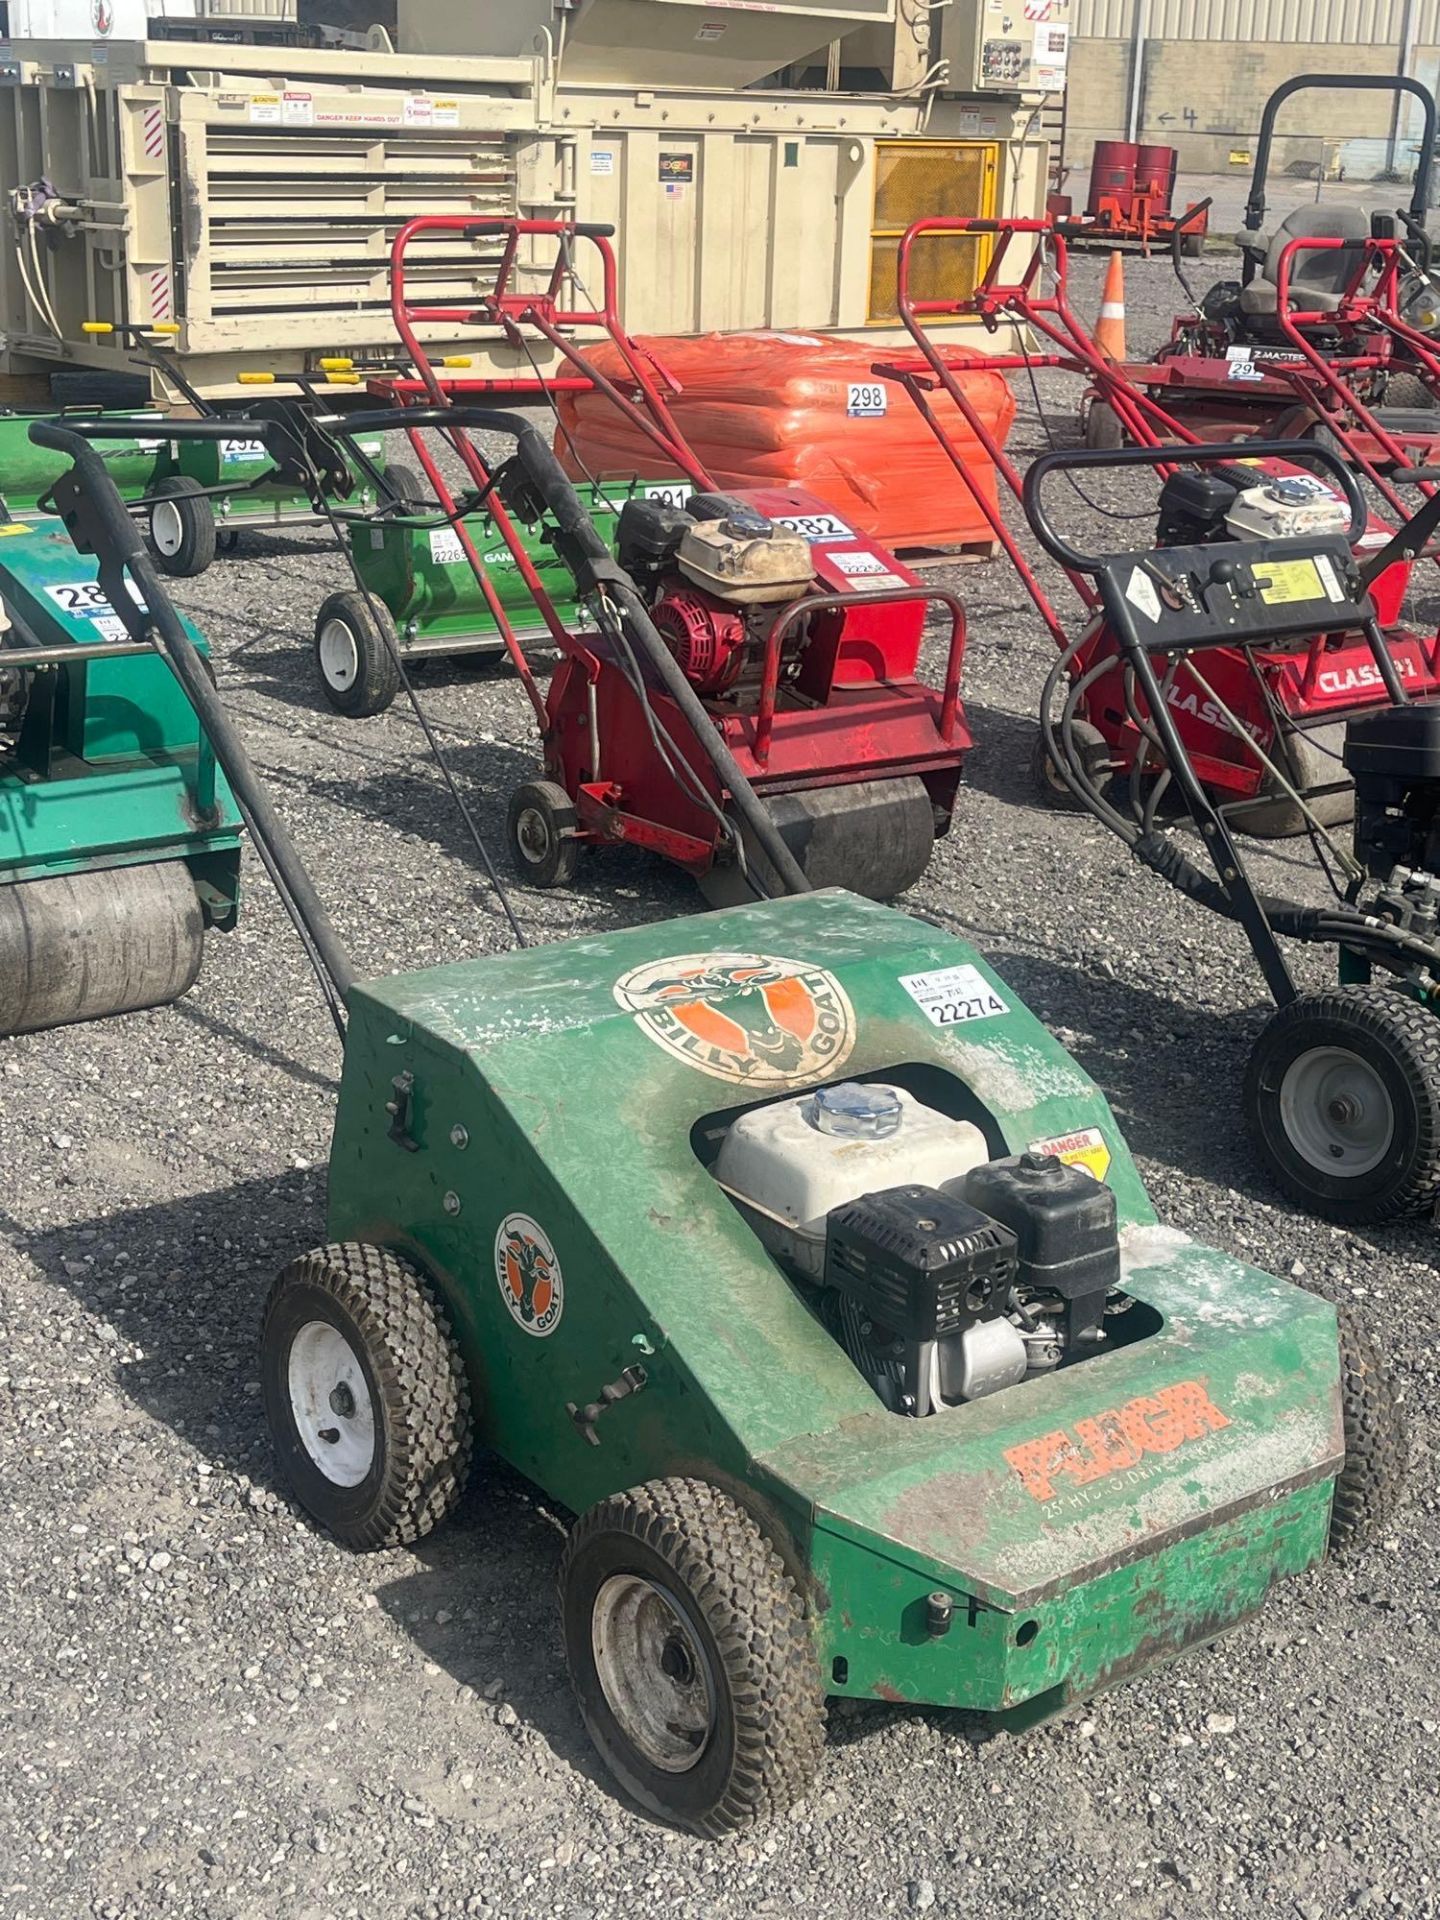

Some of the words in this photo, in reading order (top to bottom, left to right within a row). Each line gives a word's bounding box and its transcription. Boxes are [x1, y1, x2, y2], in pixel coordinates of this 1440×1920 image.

[1184, 106, 1198, 128] 4
[1232, 363, 1257, 375] 29
[850, 387, 882, 407] 298
[780, 517, 843, 535] 282
[484, 552, 515, 563] GAN
[56, 585, 110, 608] 28
[801, 974, 841, 1055] GOAT
[931, 995, 1003, 1023] 22274
[650, 1011, 758, 1074] BILLY
[1041, 1134, 1092, 1156] DANGER
[499, 1249, 518, 1307] BILLY
[537, 1286, 559, 1328] GOAT
